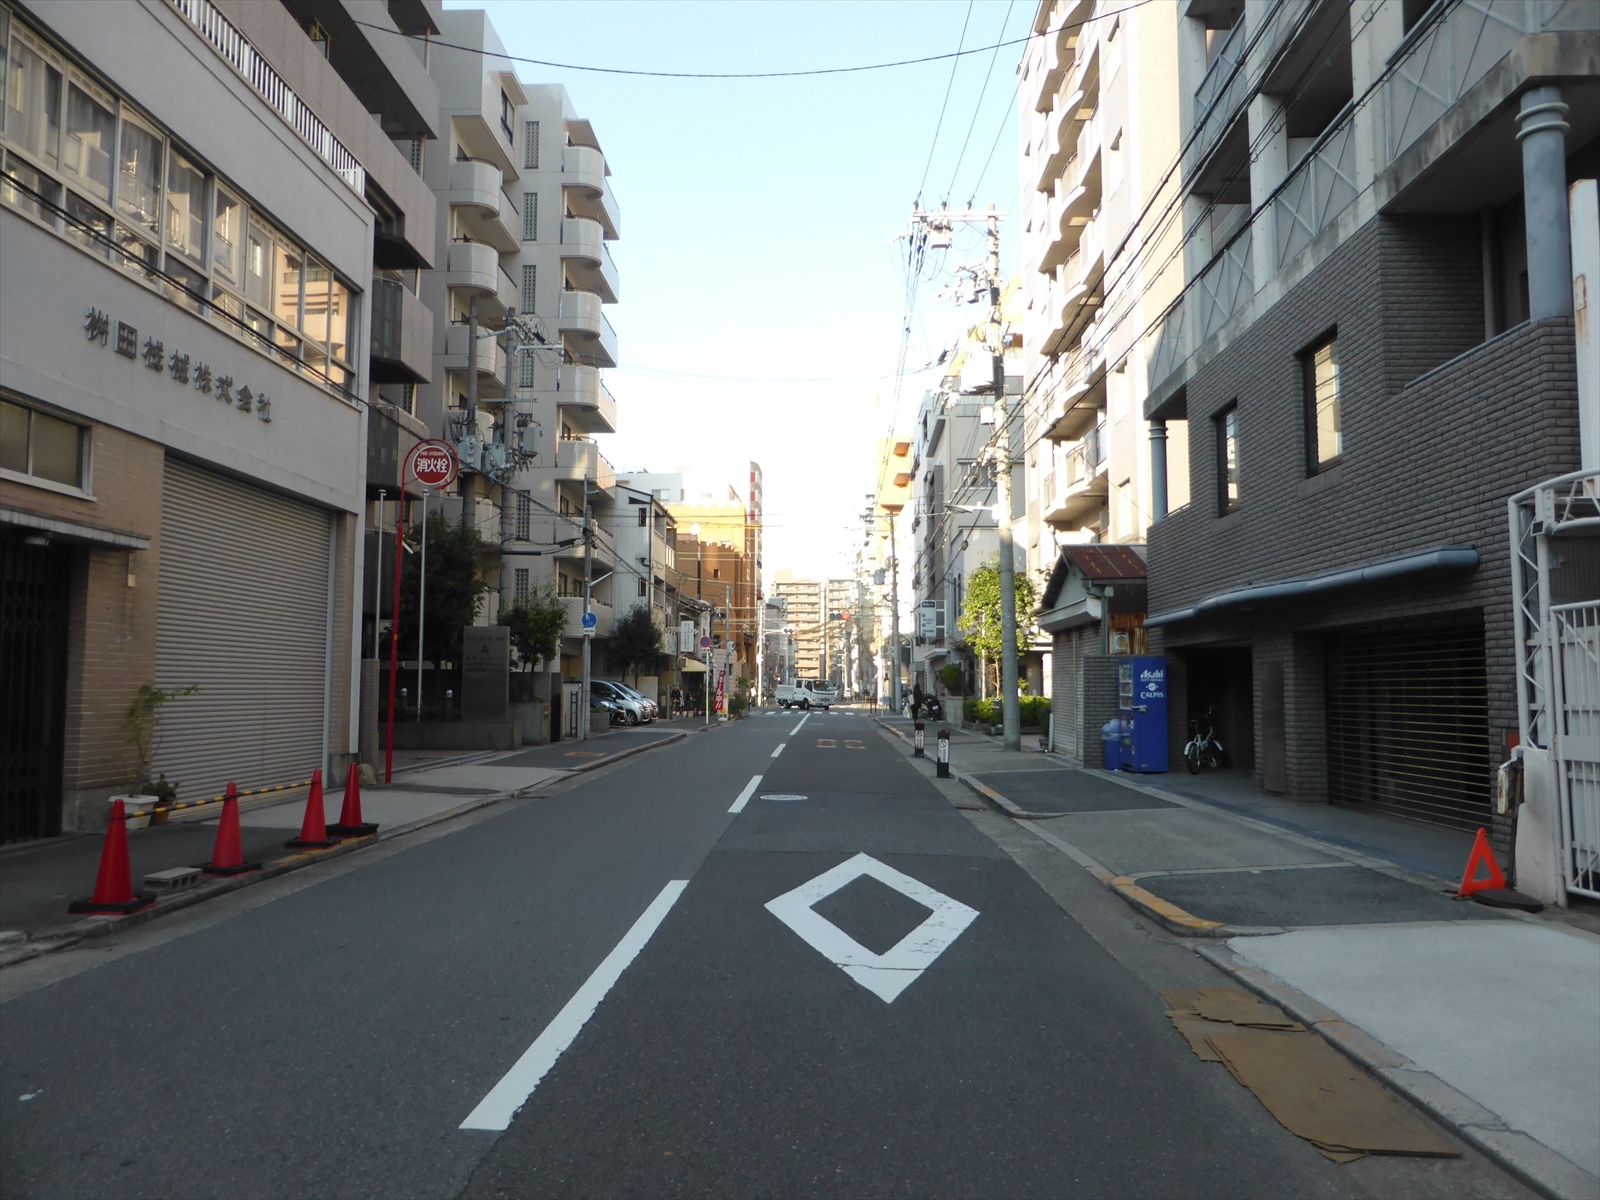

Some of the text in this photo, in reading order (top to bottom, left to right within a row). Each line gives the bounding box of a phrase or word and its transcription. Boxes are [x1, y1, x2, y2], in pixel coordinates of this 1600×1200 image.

[417, 457, 448, 473] 消火栓
[1140, 669, 1164, 679] Asahi
[1140, 691, 1164, 699] CALPIS
